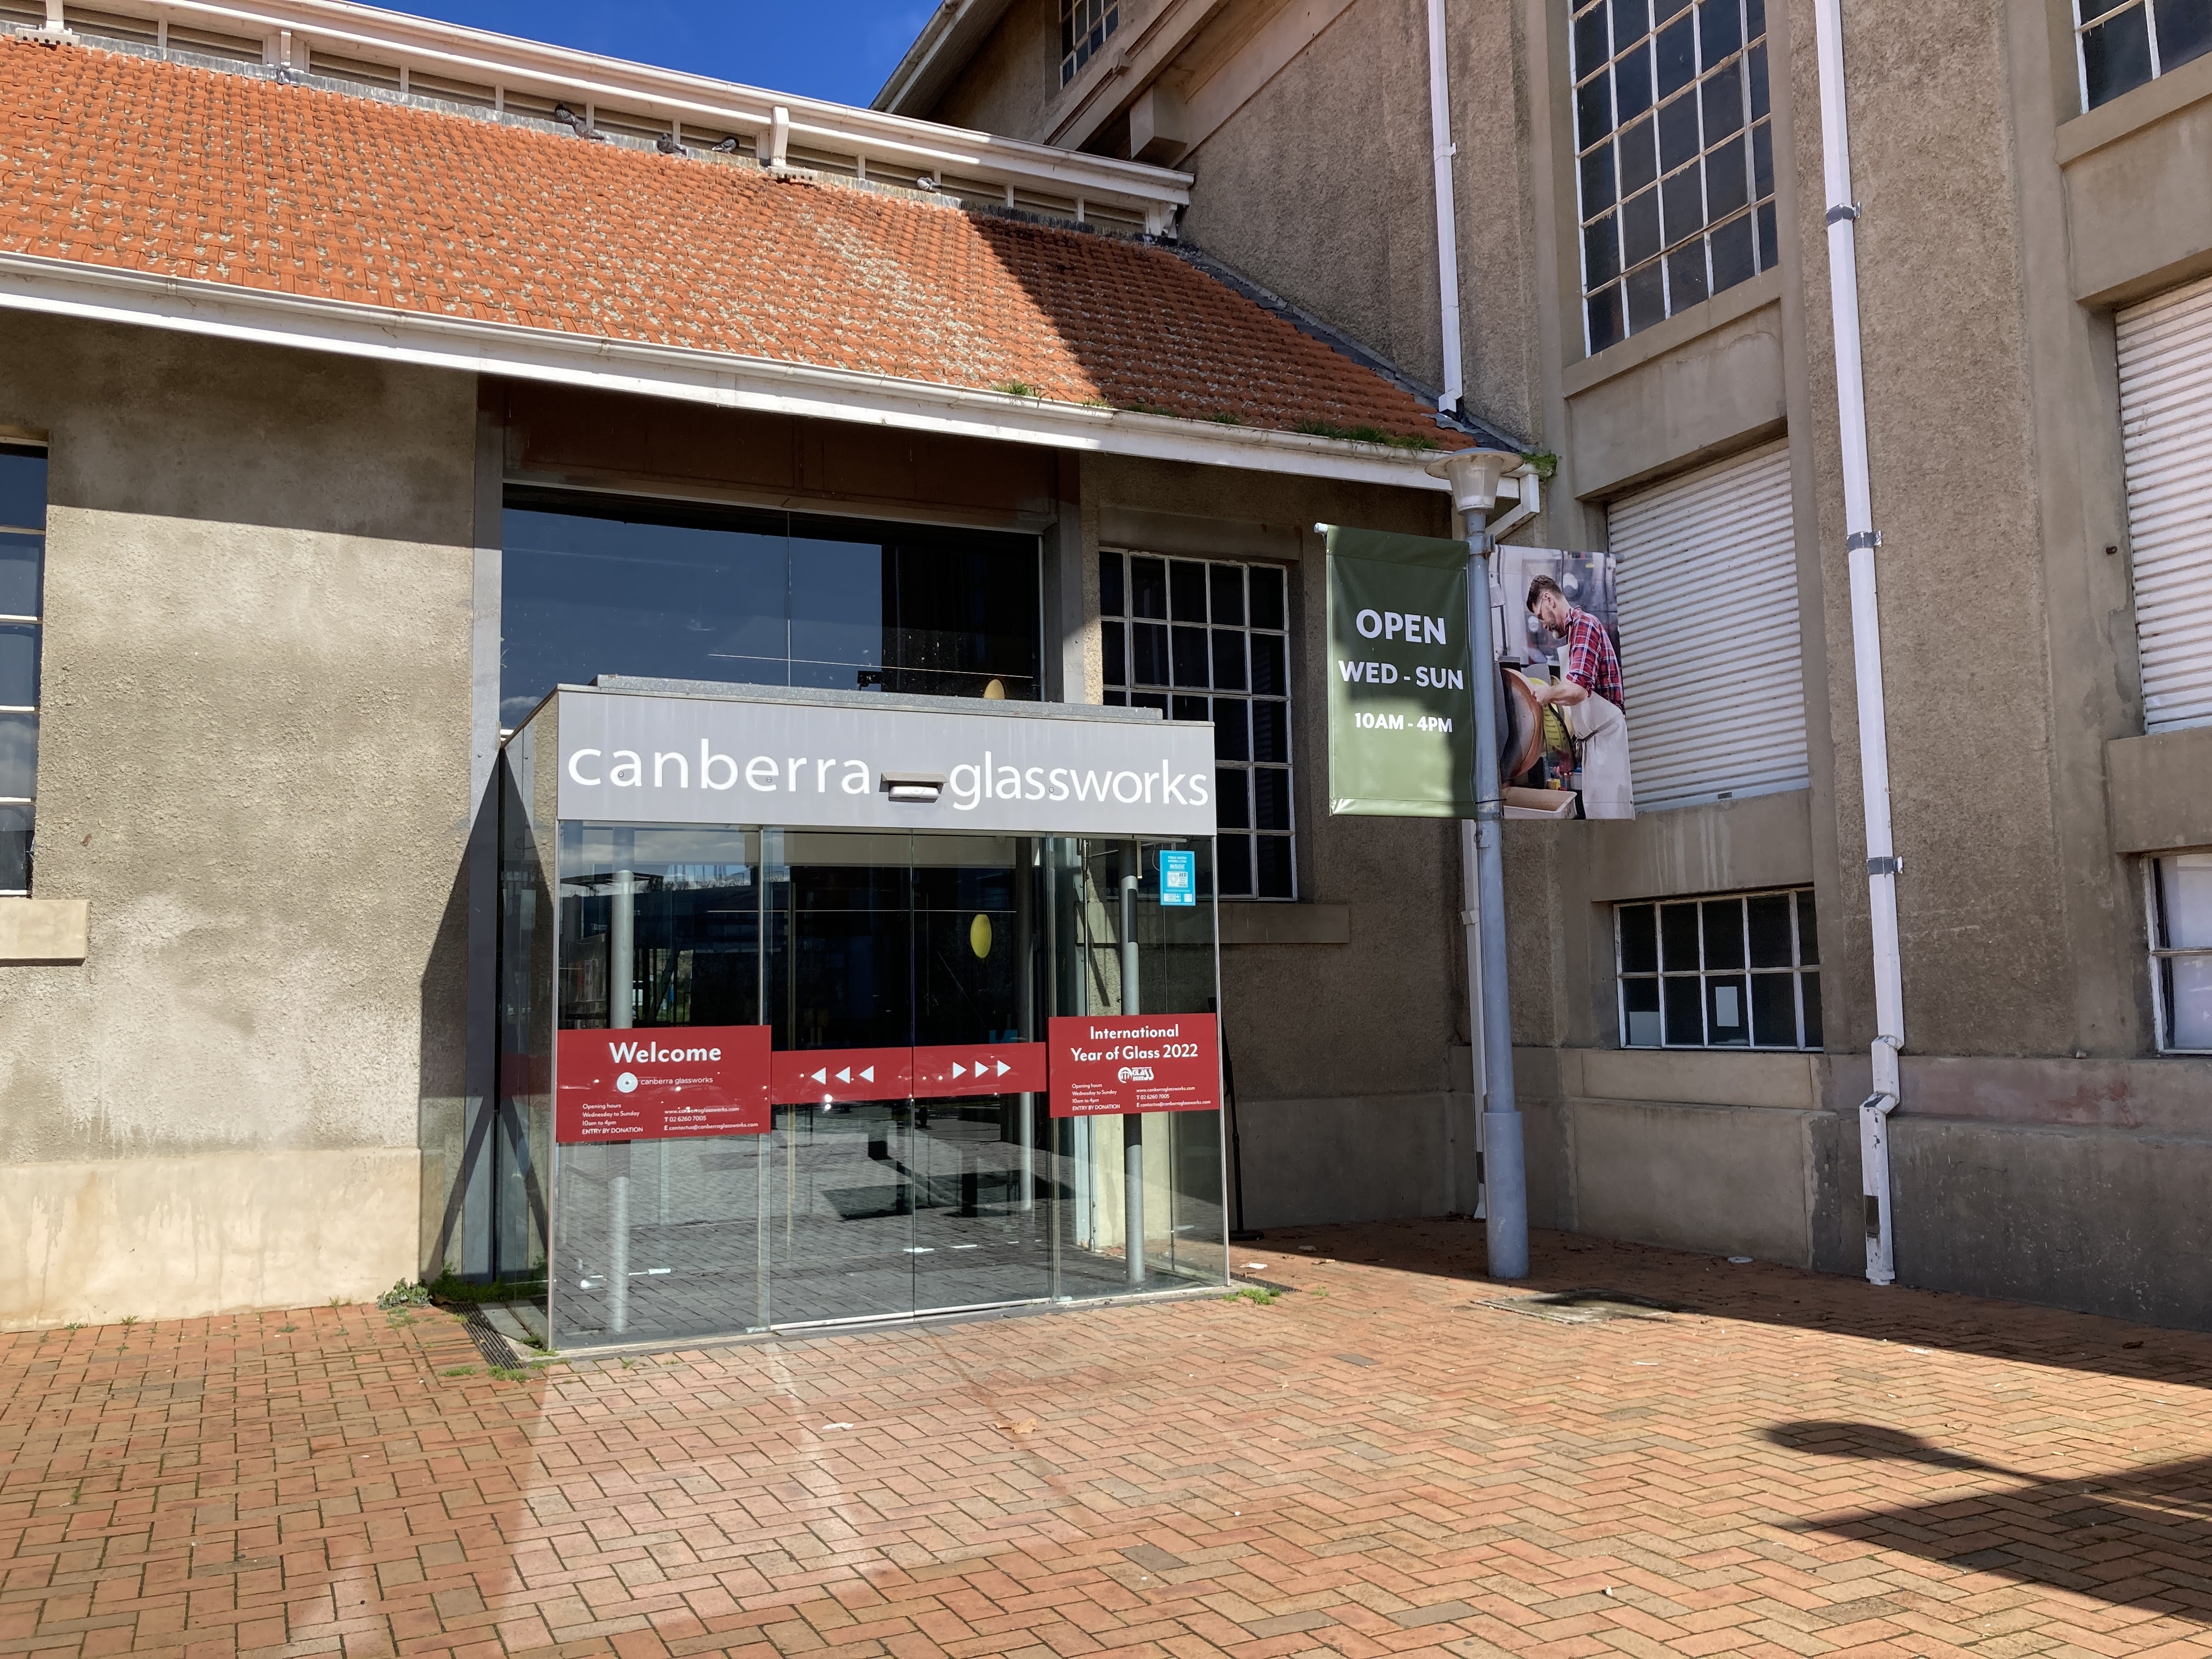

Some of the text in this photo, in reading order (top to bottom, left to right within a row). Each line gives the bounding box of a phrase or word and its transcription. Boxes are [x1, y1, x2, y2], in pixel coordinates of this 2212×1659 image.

[1356, 609, 1447, 645] OPEN
[1338, 660, 1398, 684] WED
[1416, 667, 1464, 690] SUN
[1355, 712, 1404, 730] 10AM
[1417, 716, 1453, 732] 4PM
[568, 738, 1210, 810] canberra glassworks
[1091, 1024, 1179, 1040] International
[609, 1041, 721, 1063] Welcome
[1071, 1043, 1198, 1062] Year of Glass 2022
[641, 1076, 714, 1085] canberra glassworks
